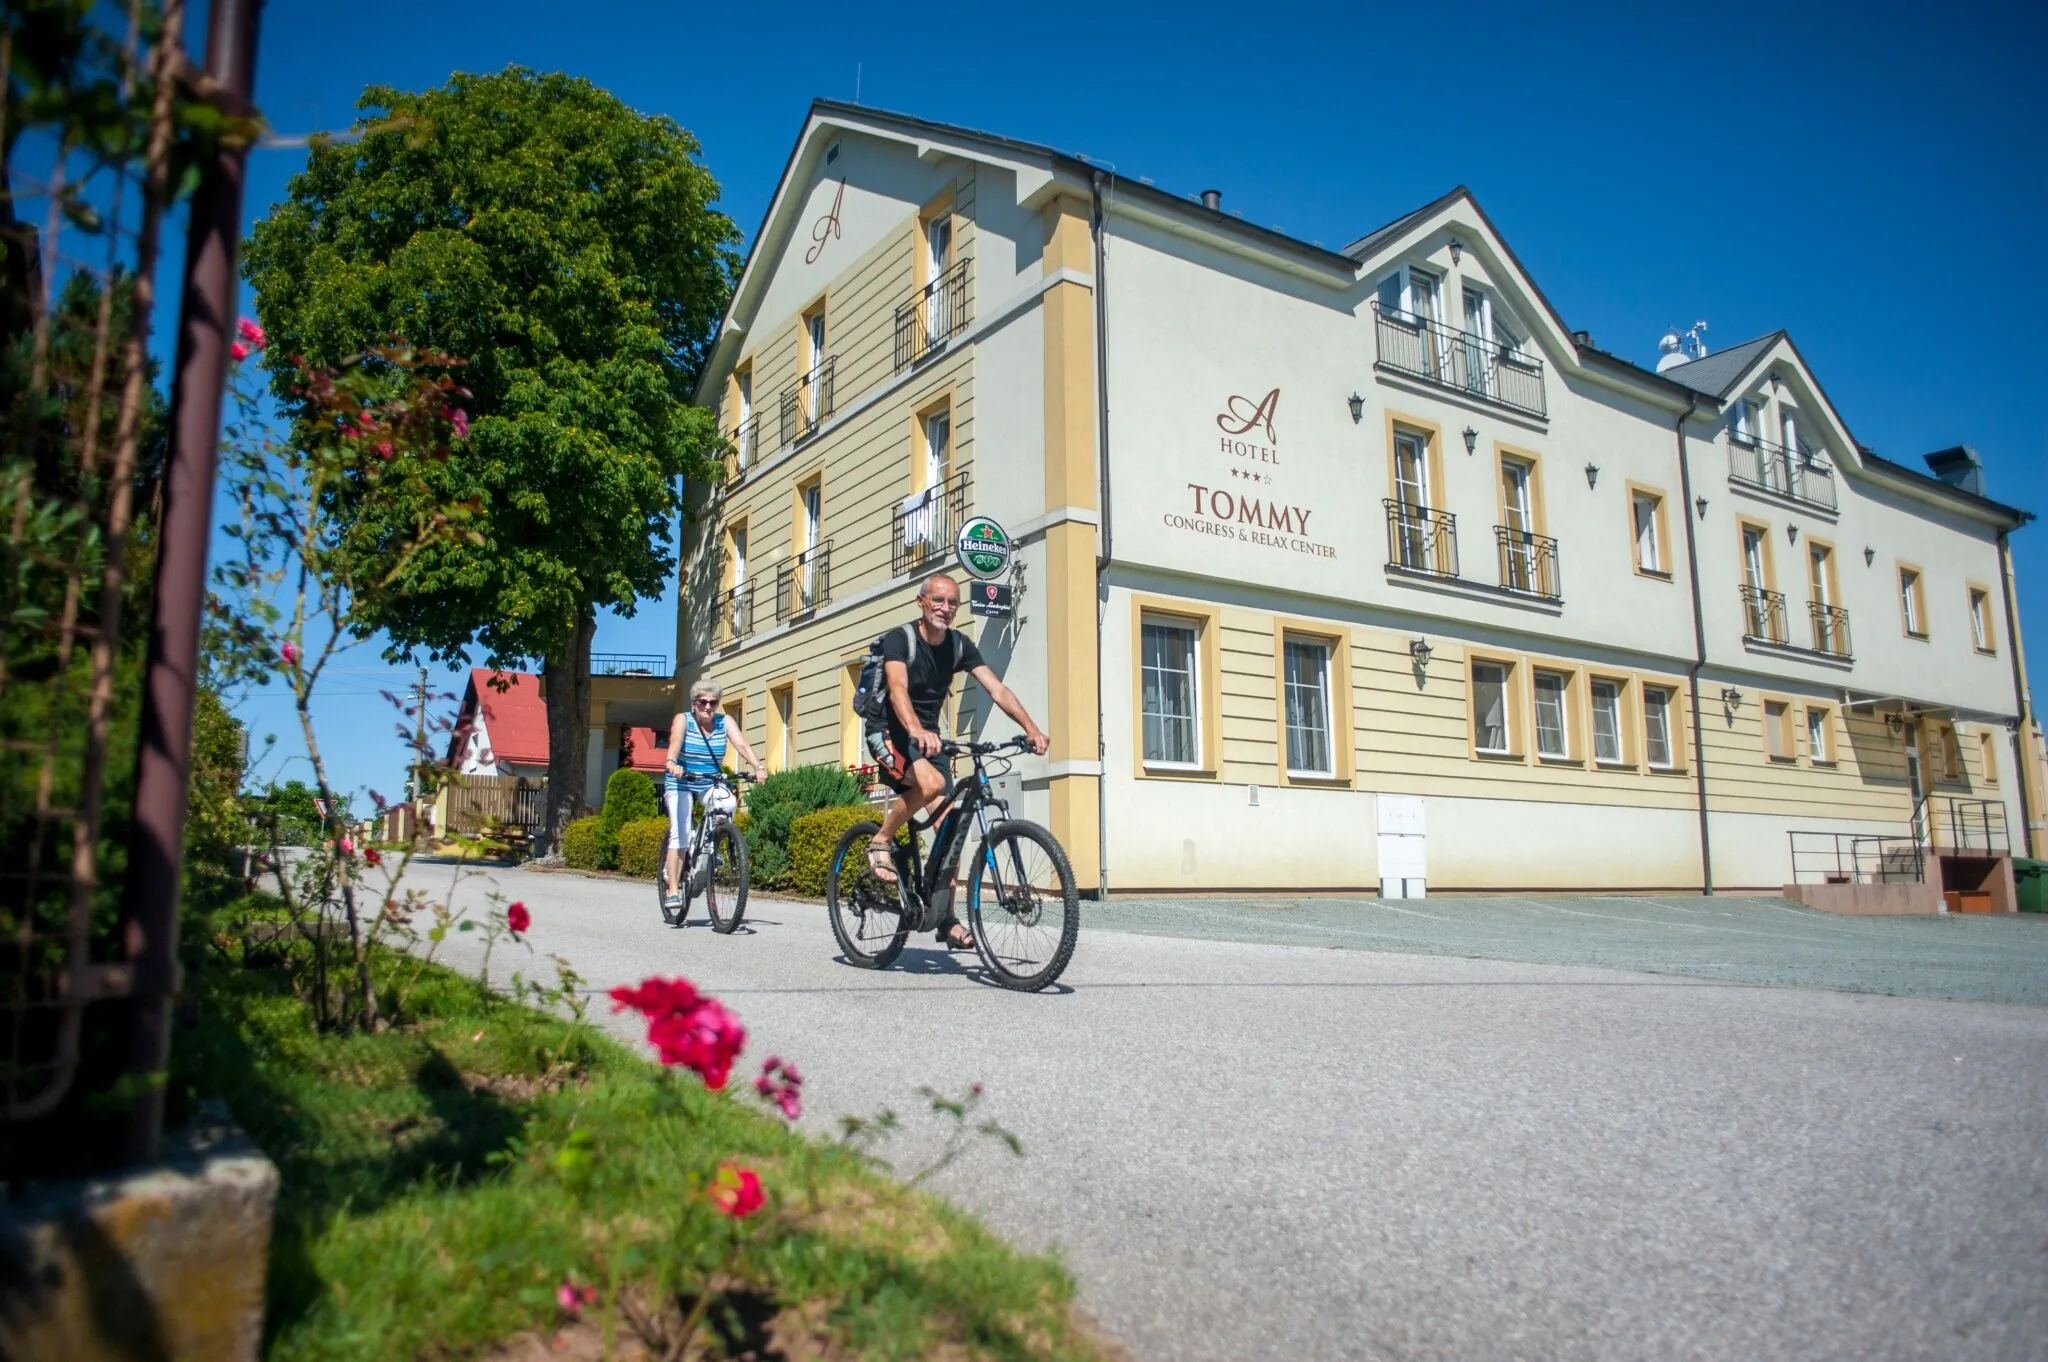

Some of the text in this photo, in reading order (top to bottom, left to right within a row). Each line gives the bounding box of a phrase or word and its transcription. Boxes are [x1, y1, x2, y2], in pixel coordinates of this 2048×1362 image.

[1220, 437, 1280, 465] HOTEL
[1187, 482, 1312, 537] TOMMY
[963, 540, 1007, 555] Heineken
[1163, 513, 1338, 560] CONGRESS & RELAX CENTER
